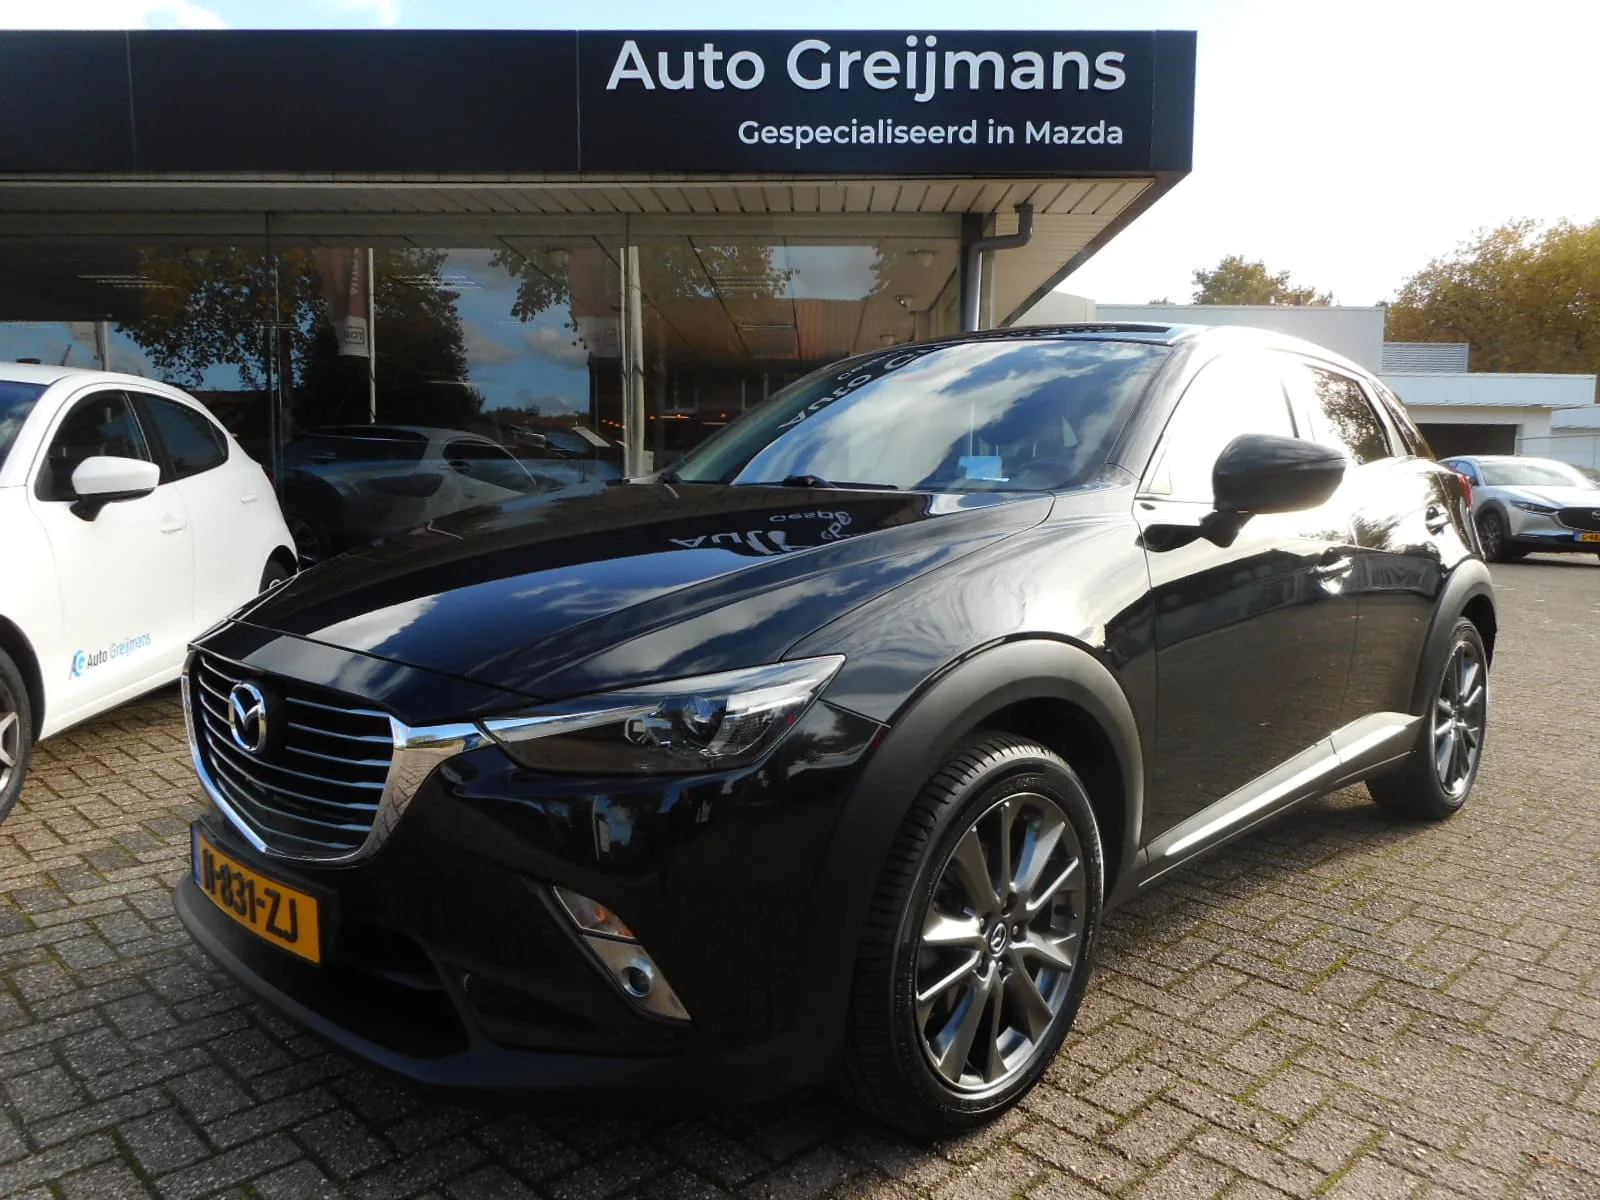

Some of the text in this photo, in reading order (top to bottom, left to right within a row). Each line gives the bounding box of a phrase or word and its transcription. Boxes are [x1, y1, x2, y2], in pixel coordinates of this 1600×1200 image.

[606, 35, 1126, 103] Auto Greijmans
[738, 119, 1123, 149] Gespecialiseerd in Mazda
[87, 633, 152, 668] Auto Greijmans
